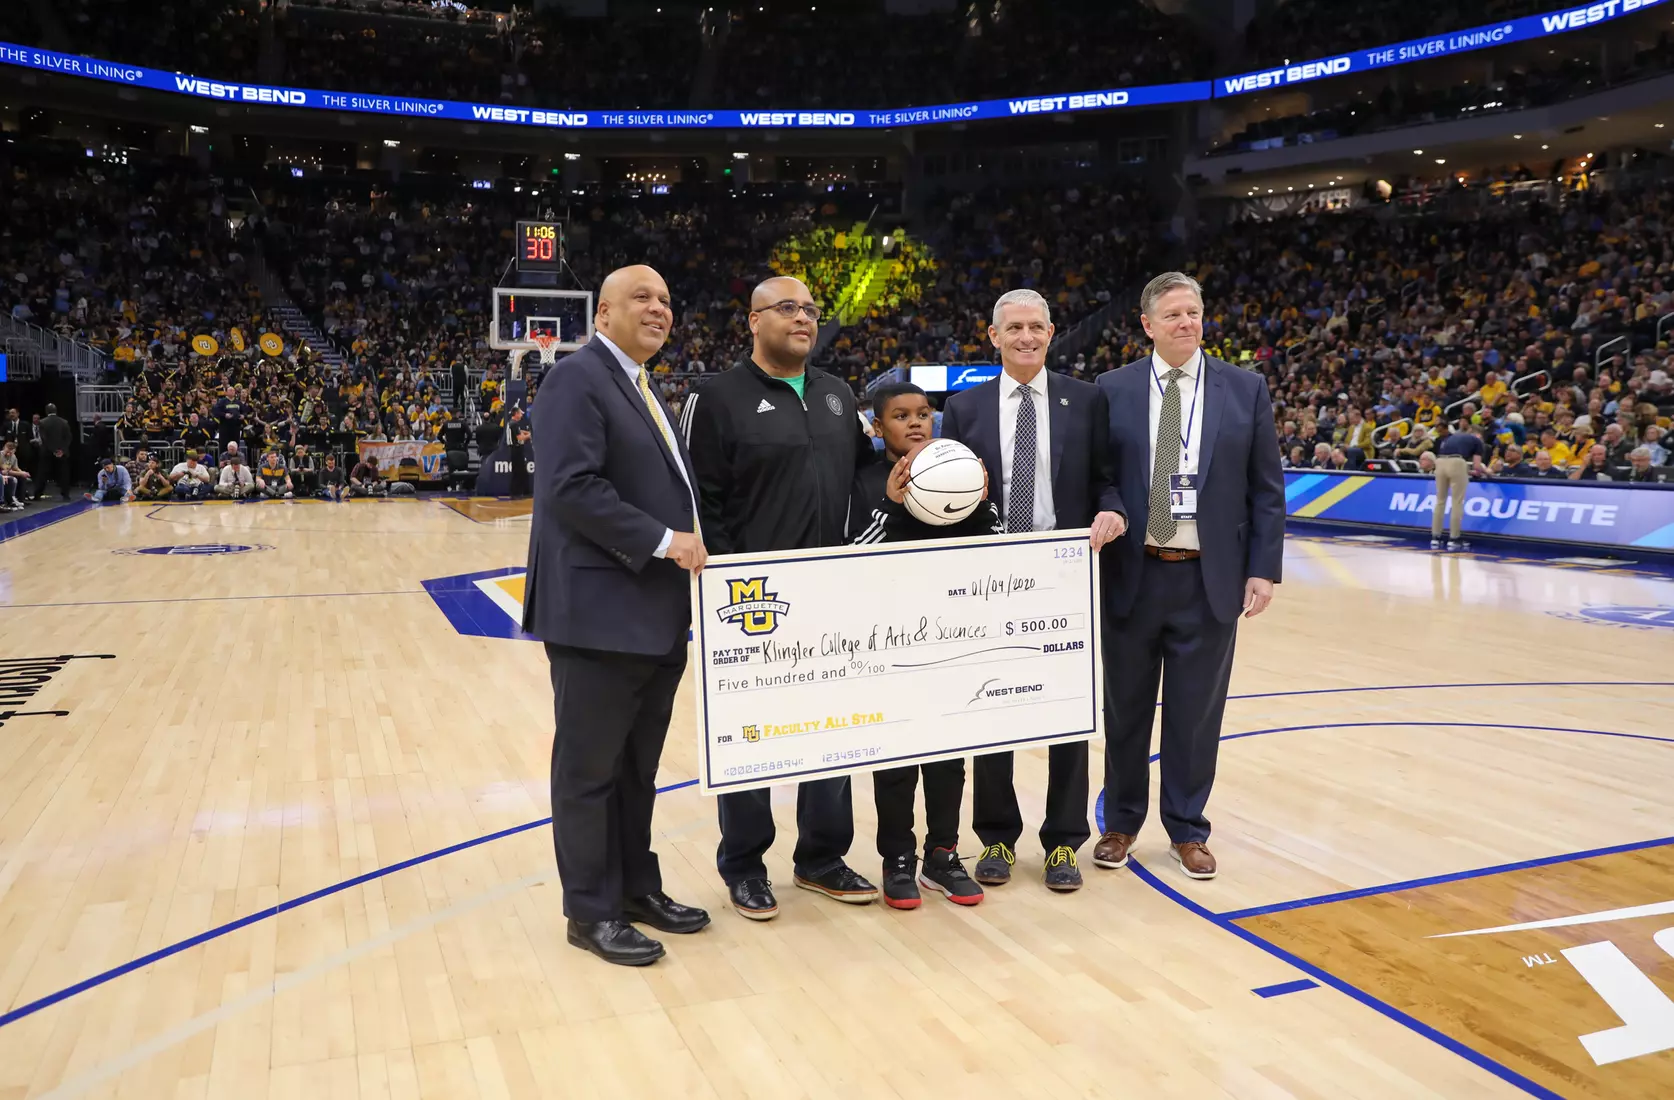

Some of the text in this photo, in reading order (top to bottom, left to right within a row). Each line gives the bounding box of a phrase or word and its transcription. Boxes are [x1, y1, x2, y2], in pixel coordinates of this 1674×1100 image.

[1541, 0, 1621, 33] WEST
[0, 46, 28, 63] THE
[33, 53, 81, 72] SILVER
[1366, 48, 1395, 66] THE
[1398, 39, 1446, 60] SILVER
[1224, 56, 1351, 94] WEST BEND
[175, 76, 307, 105] WEST BEND
[322, 94, 347, 107] THE
[351, 97, 391, 111] SILVER
[1008, 91, 1129, 114] WEST BEND
[472, 105, 588, 126] WEST BEND
[602, 114, 624, 125] THE
[628, 114, 664, 125] SILVER
[740, 112, 855, 126] WEST BEND
[869, 113, 891, 125] THE
[894, 110, 930, 124] SILVER
[526, 226, 556, 239] 11:06
[527, 238, 552, 259] 30
[1053, 546, 1083, 559] 1234
[948, 588, 967, 597] DATE
[722, 602, 786, 616] MARQUETTE
[1005, 618, 1068, 636] $ 500.00
[763, 639, 815, 668] Klingler
[821, 632, 860, 661] College
[868, 624, 878, 651] of
[885, 625, 911, 649] Arts
[914, 616, 928, 641] &
[1043, 641, 1084, 653] DOLLARS
[712, 646, 760, 658] PAY TO THE
[713, 654, 750, 666] ORDER OF
[718, 678, 749, 691] Five
[755, 669, 815, 687] hundred
[821, 666, 846, 680] and
[986, 684, 1043, 697] WEST BEND
[764, 720, 820, 737] FACULTY
[825, 716, 848, 729] ALL
[852, 712, 883, 725] STAR
[717, 735, 733, 744] FOR
